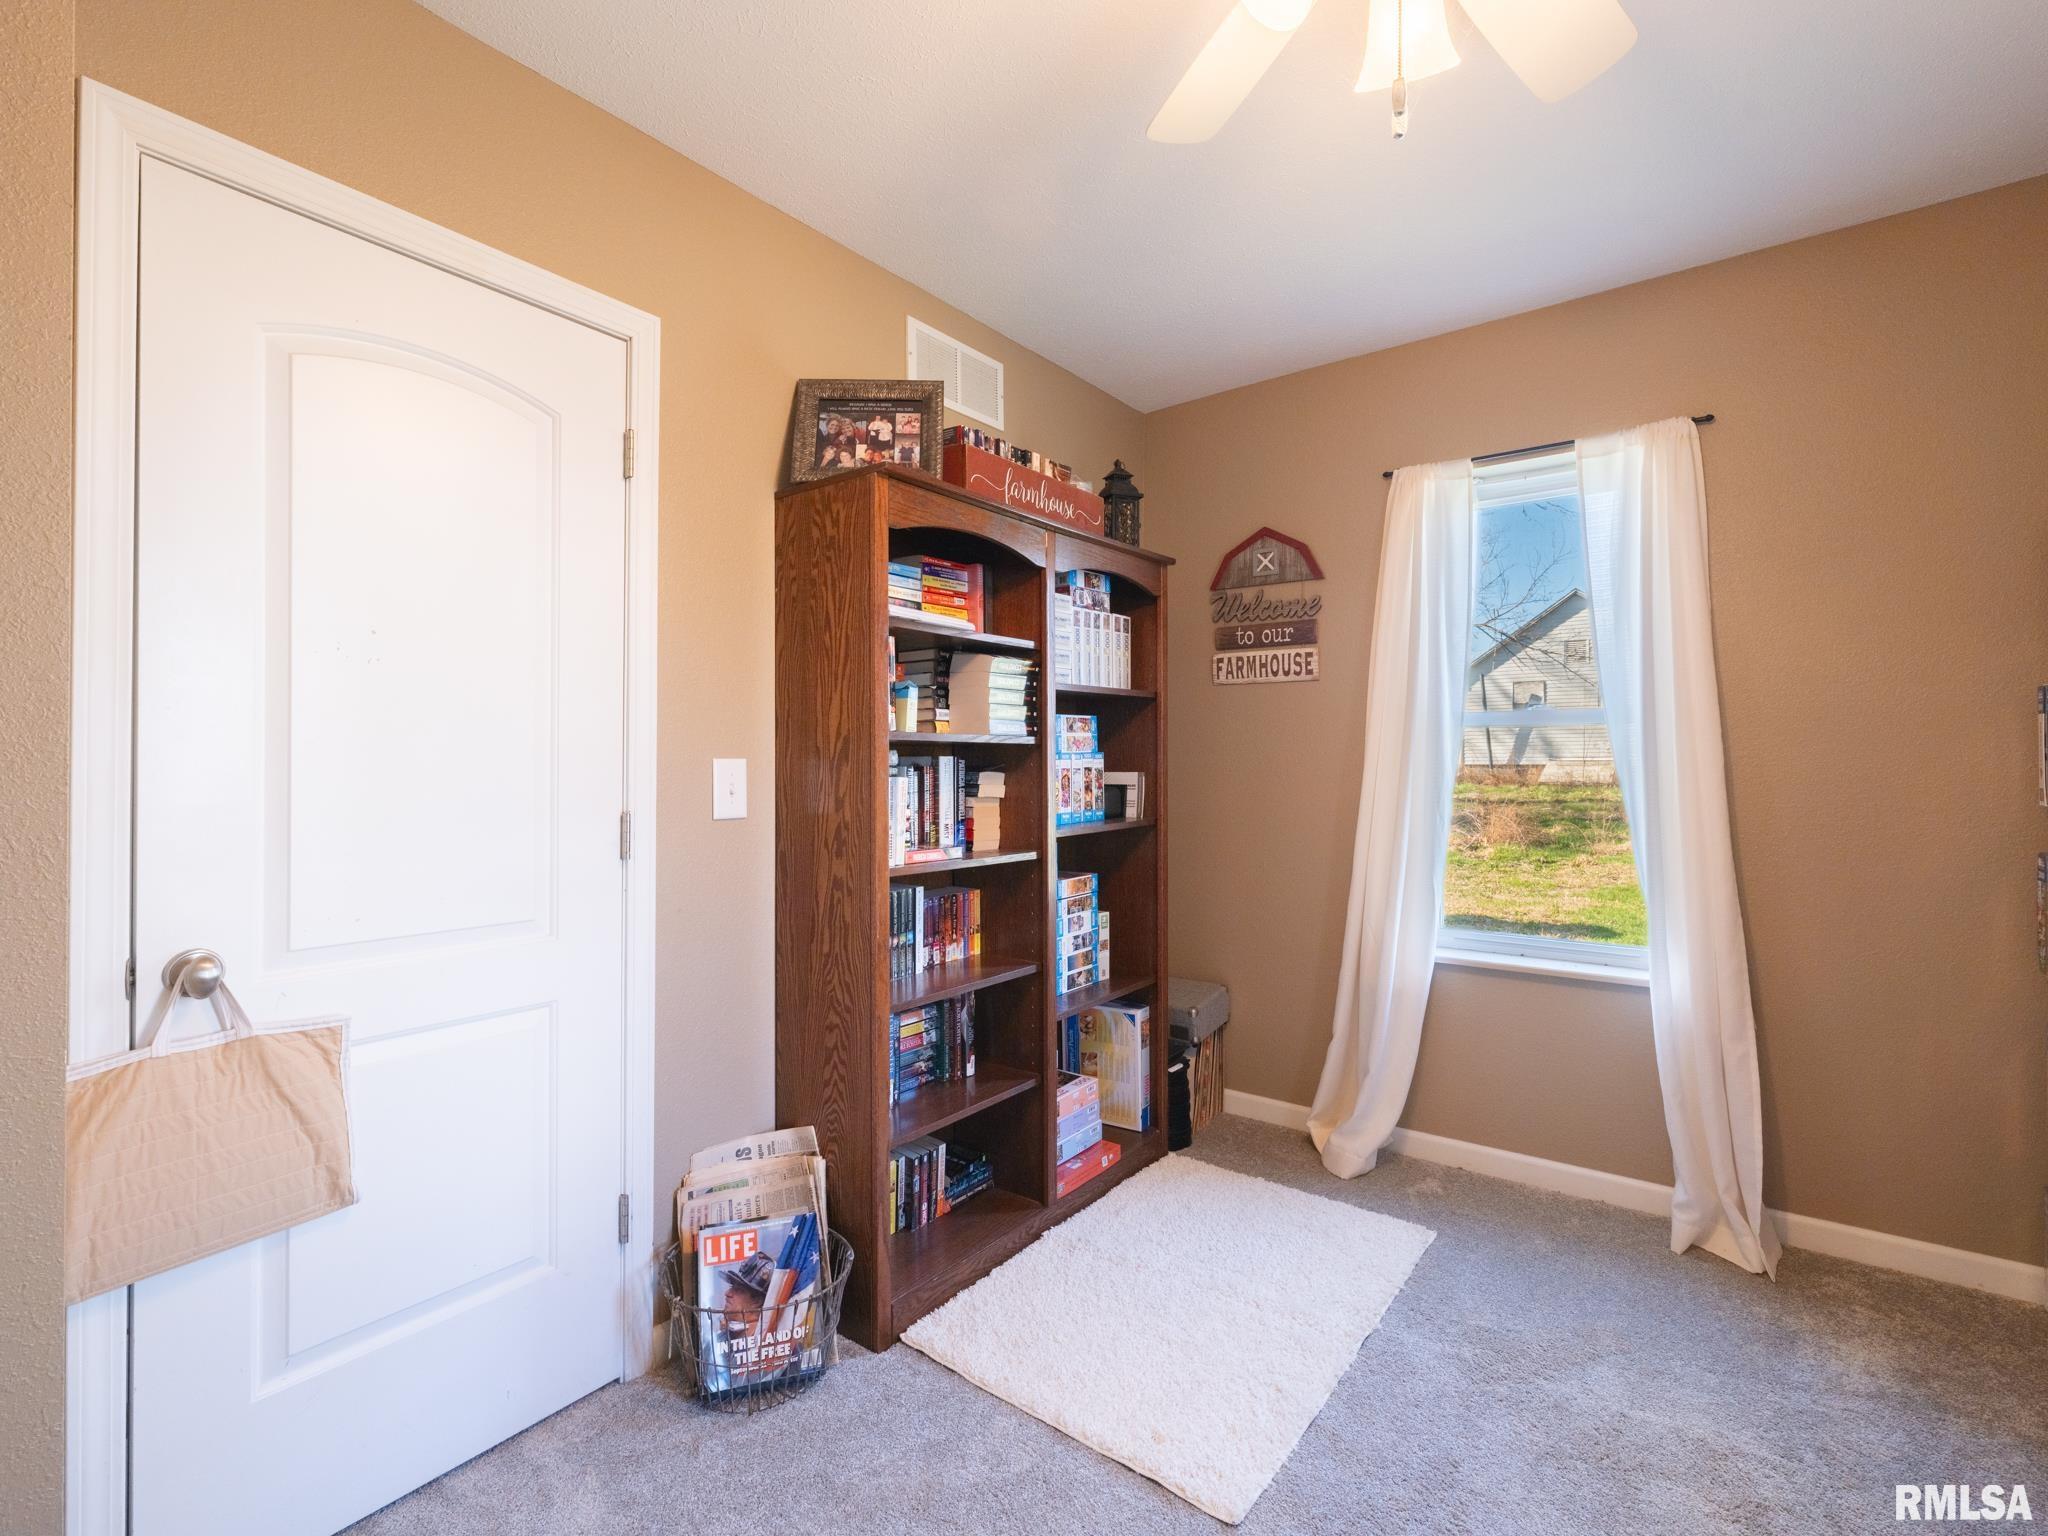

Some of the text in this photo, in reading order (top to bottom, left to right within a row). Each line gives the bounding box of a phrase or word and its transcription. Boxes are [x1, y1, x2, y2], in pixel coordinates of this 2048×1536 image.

[971, 467, 1101, 525] farmhouse
[1210, 589, 1322, 623] Welcome
[1236, 627, 1294, 645] to our
[1216, 651, 1314, 680] FARMHOUSE
[705, 1232, 756, 1264] LIFE
[731, 1336, 756, 1352] THE
[757, 1329, 792, 1347] LAND
